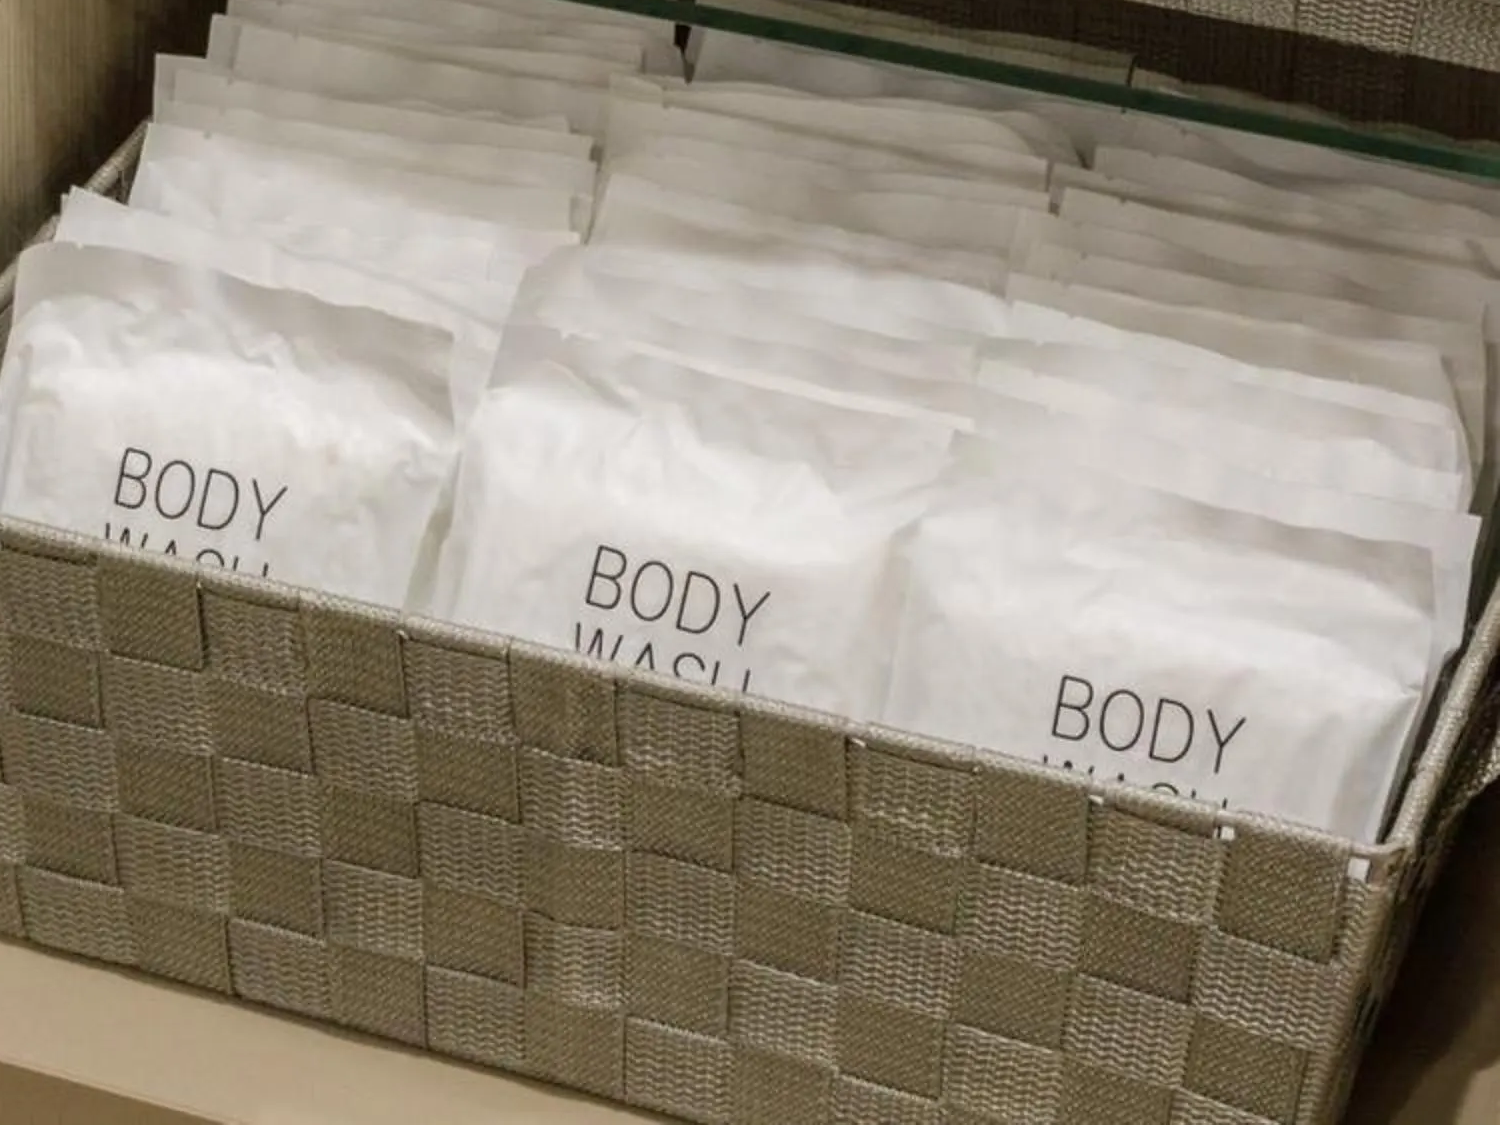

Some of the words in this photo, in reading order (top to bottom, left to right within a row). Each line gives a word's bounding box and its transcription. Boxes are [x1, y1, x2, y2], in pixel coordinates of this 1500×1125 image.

[113, 446, 289, 542] BODY
[584, 544, 771, 646] BODY
[1051, 674, 1248, 774] BODY
